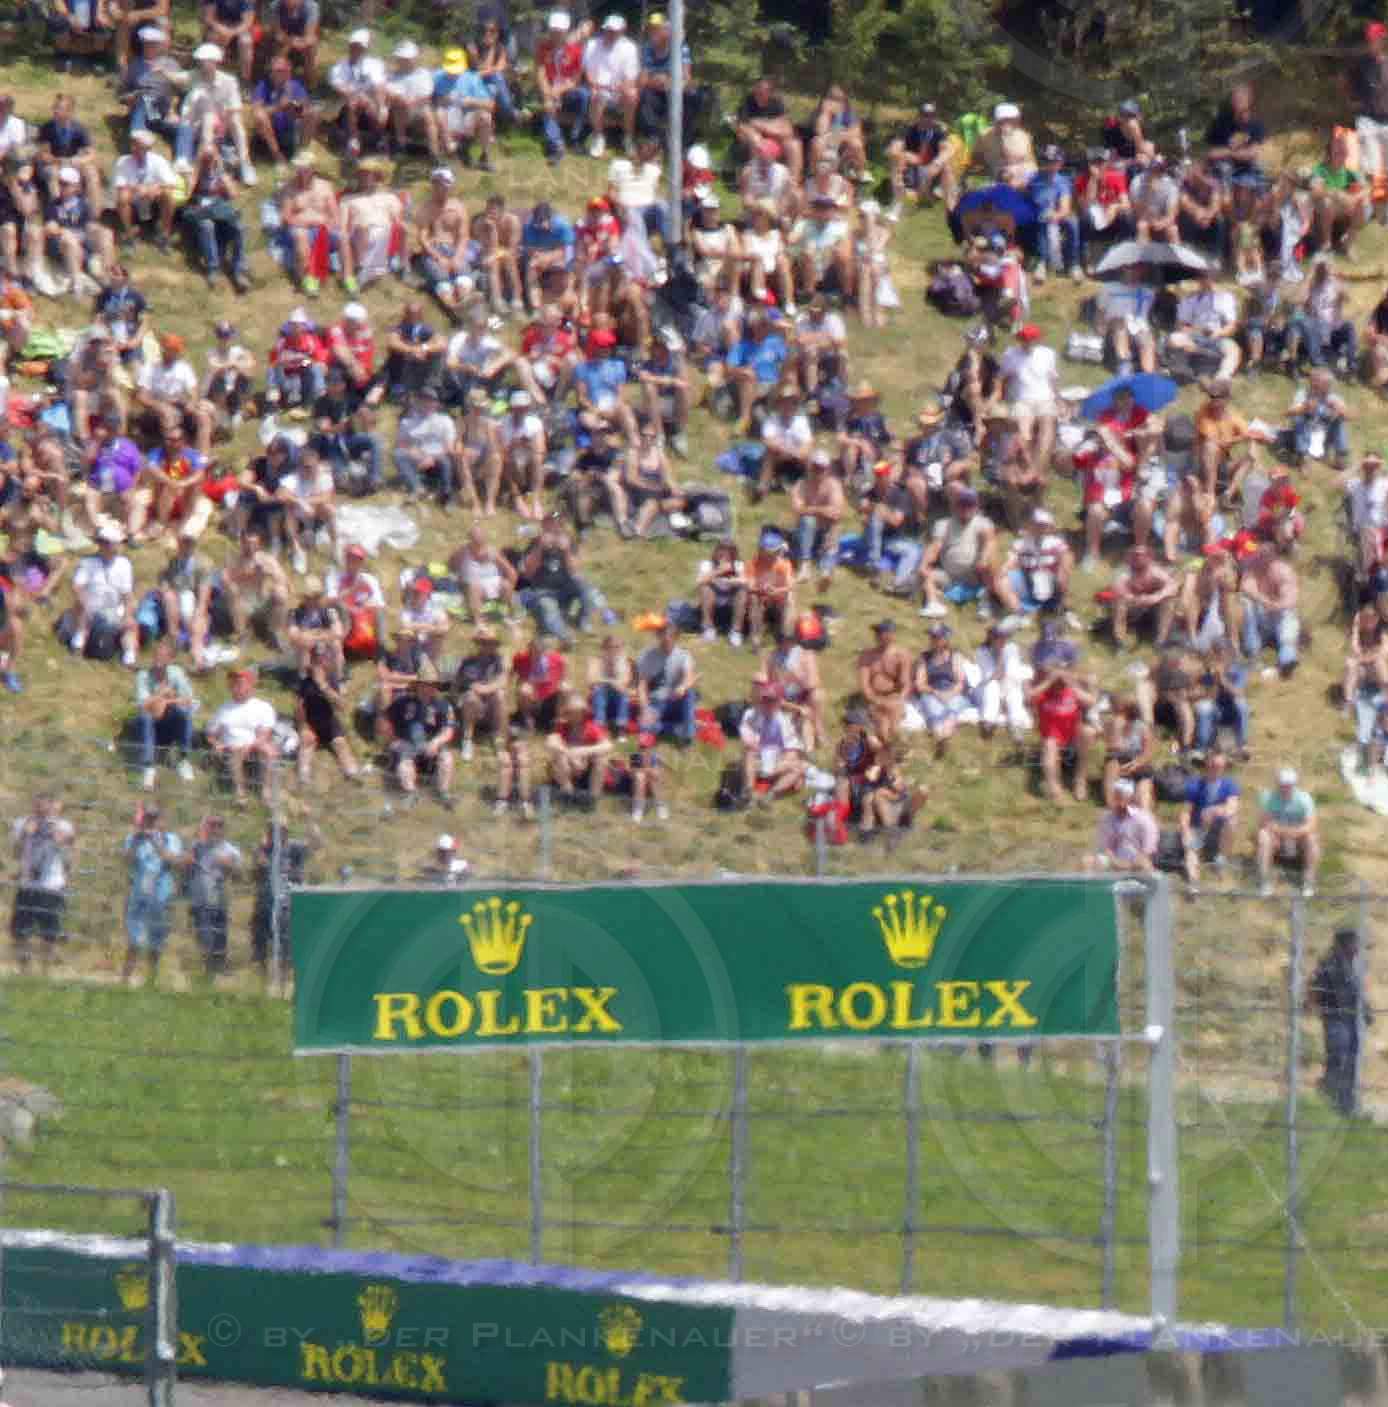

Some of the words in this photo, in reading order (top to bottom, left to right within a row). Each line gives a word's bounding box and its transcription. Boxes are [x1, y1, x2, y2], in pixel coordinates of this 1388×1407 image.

[372, 987, 622, 1040] ROLEX
[785, 980, 1040, 1030] ROLEX
[61, 1321, 207, 1366] ROLX
[300, 1344, 447, 1392] ROLEX
[545, 1361, 686, 1405] ROLEX
